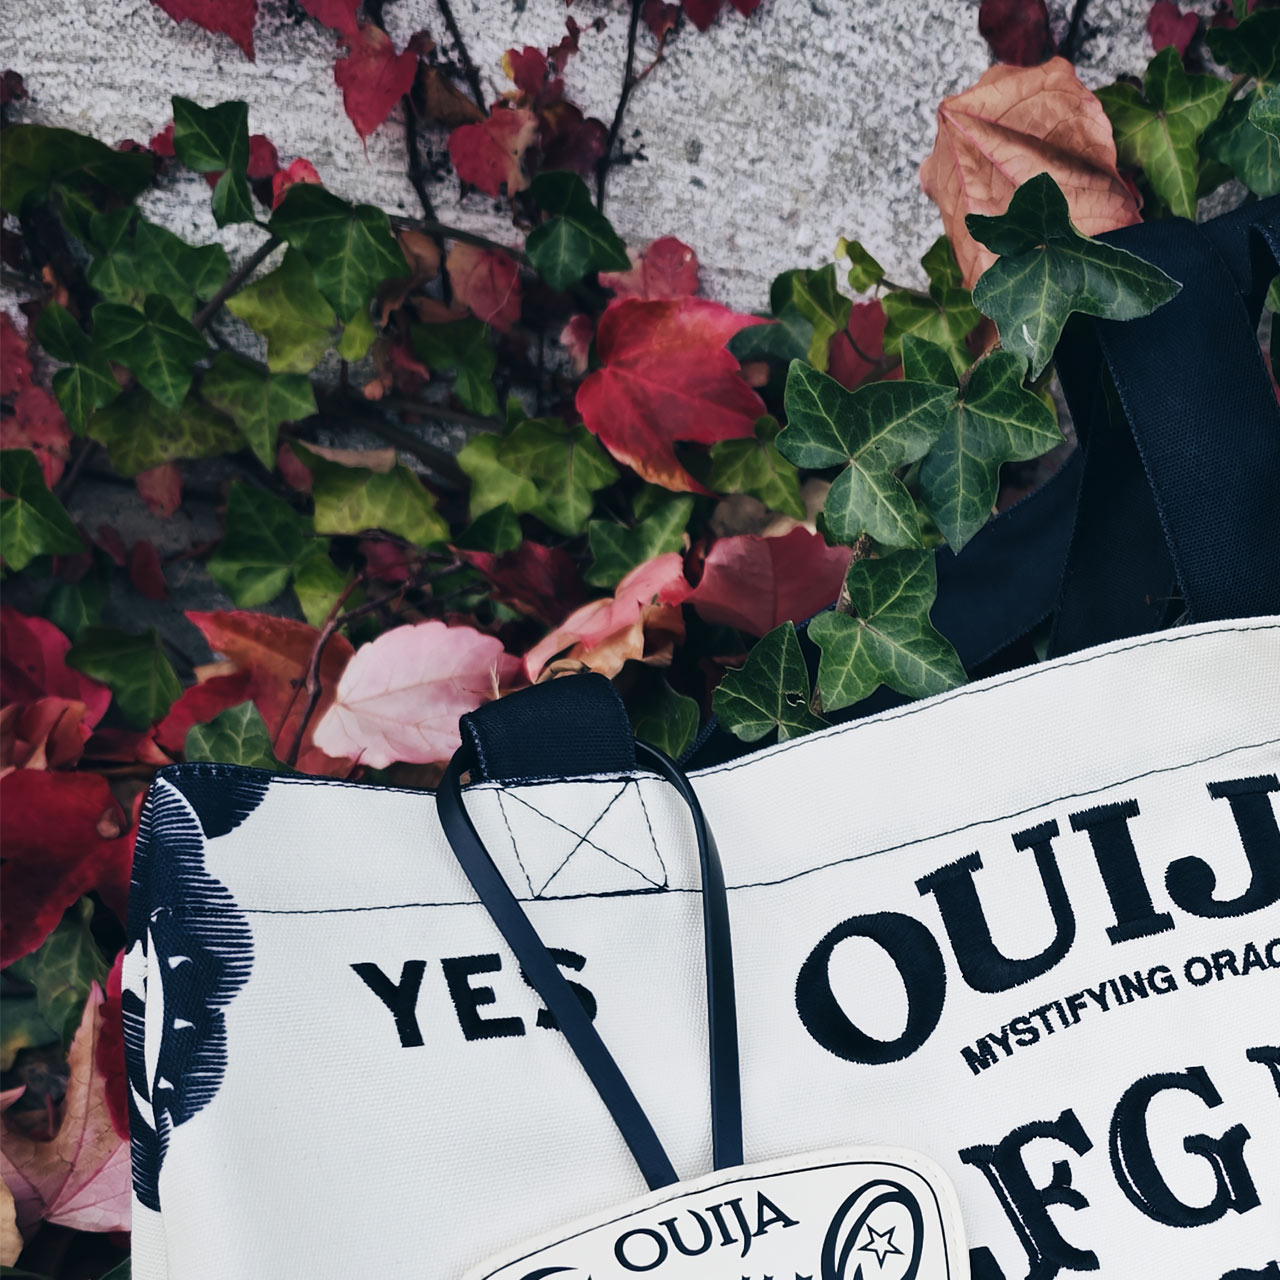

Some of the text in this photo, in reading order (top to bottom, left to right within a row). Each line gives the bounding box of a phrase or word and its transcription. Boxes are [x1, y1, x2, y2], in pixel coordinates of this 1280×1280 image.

[350, 947, 598, 1048] YES
[959, 964, 1179, 1076] MYSTIFYING
[613, 1190, 800, 1272] OUIJA
